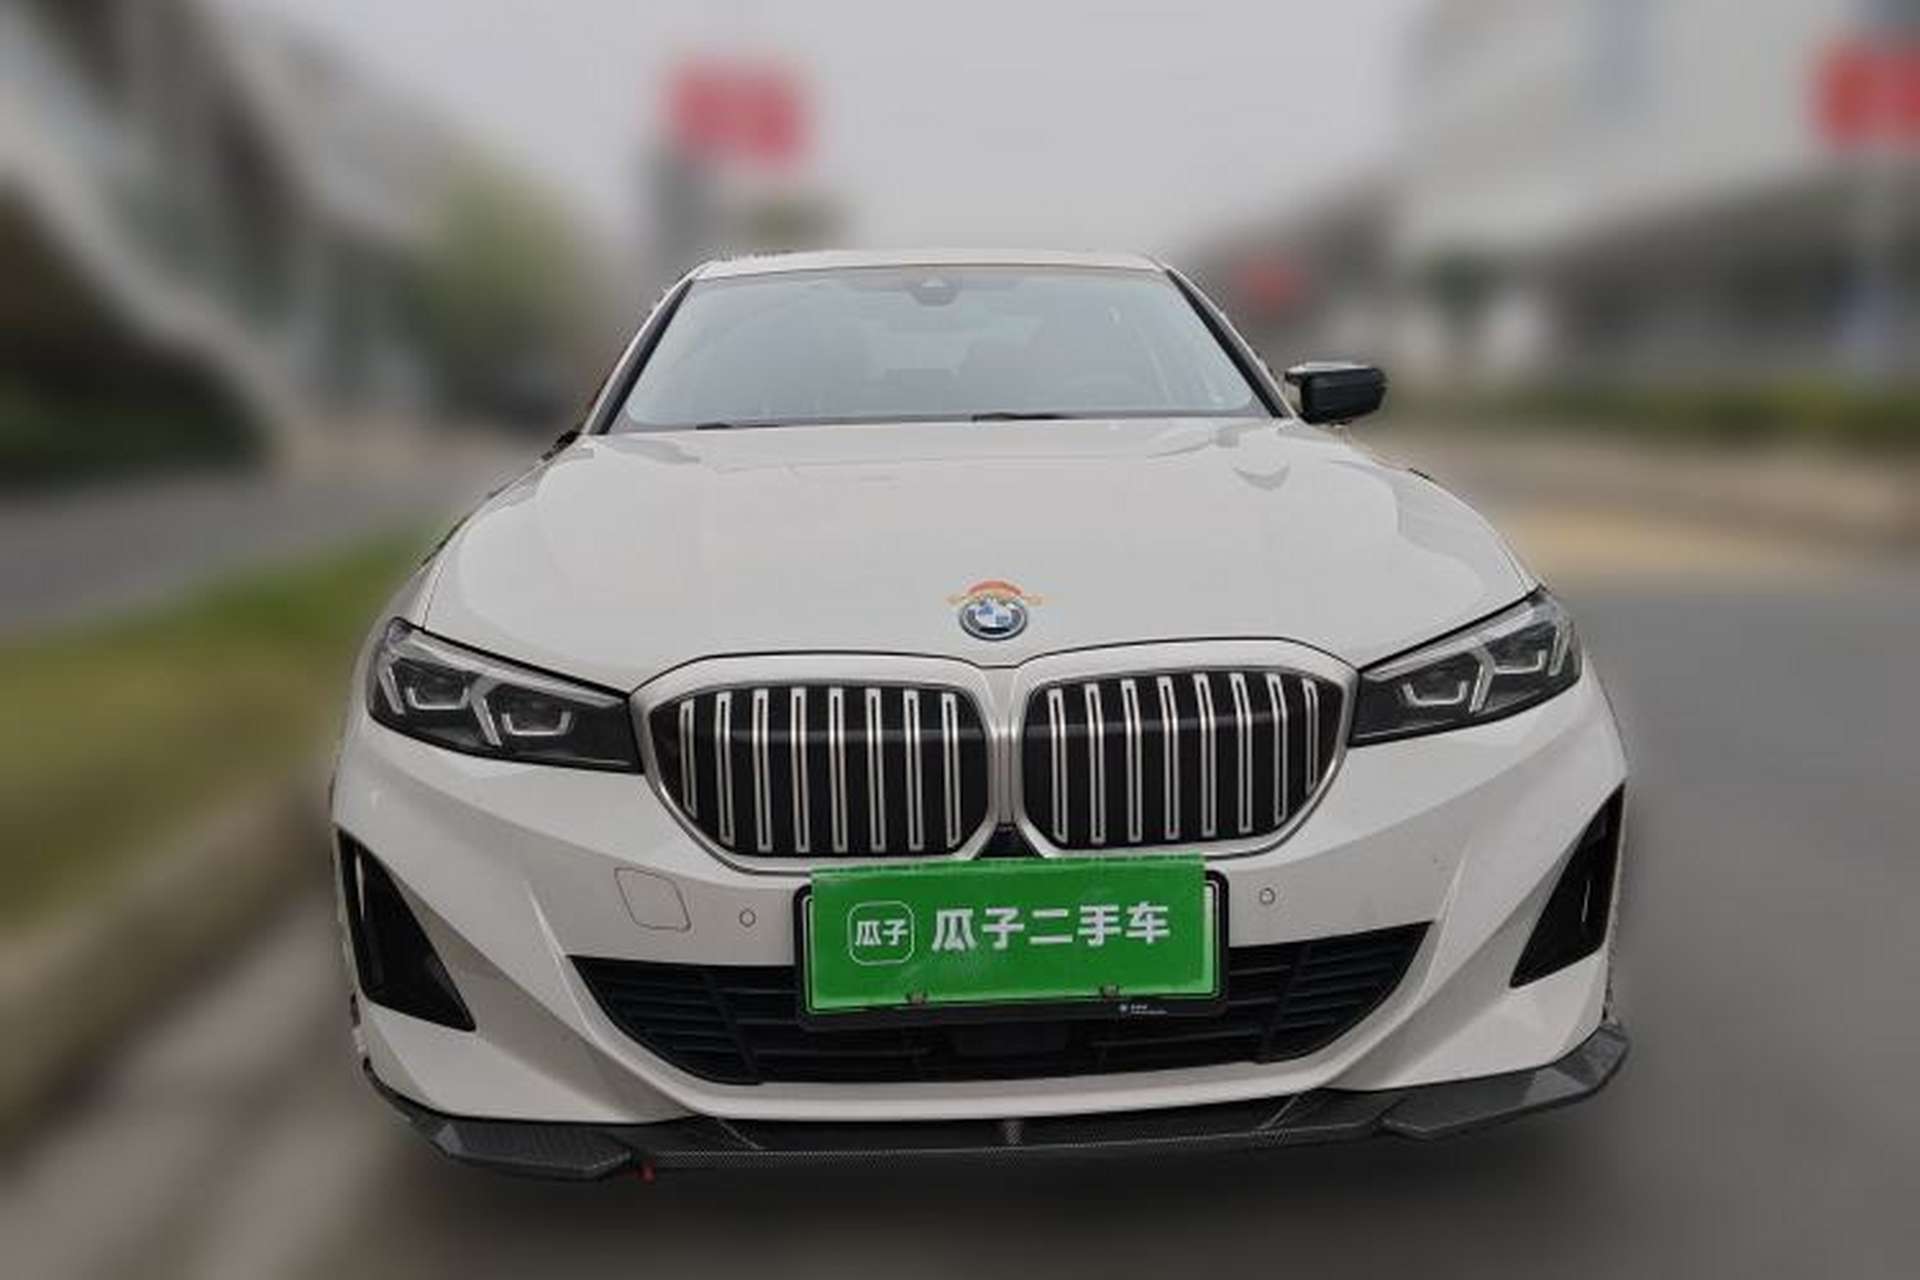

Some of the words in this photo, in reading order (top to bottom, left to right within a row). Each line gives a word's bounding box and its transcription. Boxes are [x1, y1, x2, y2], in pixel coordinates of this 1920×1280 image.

[855, 919, 909, 947] 瓜子
[931, 901, 1171, 952] 瓜子二手车
